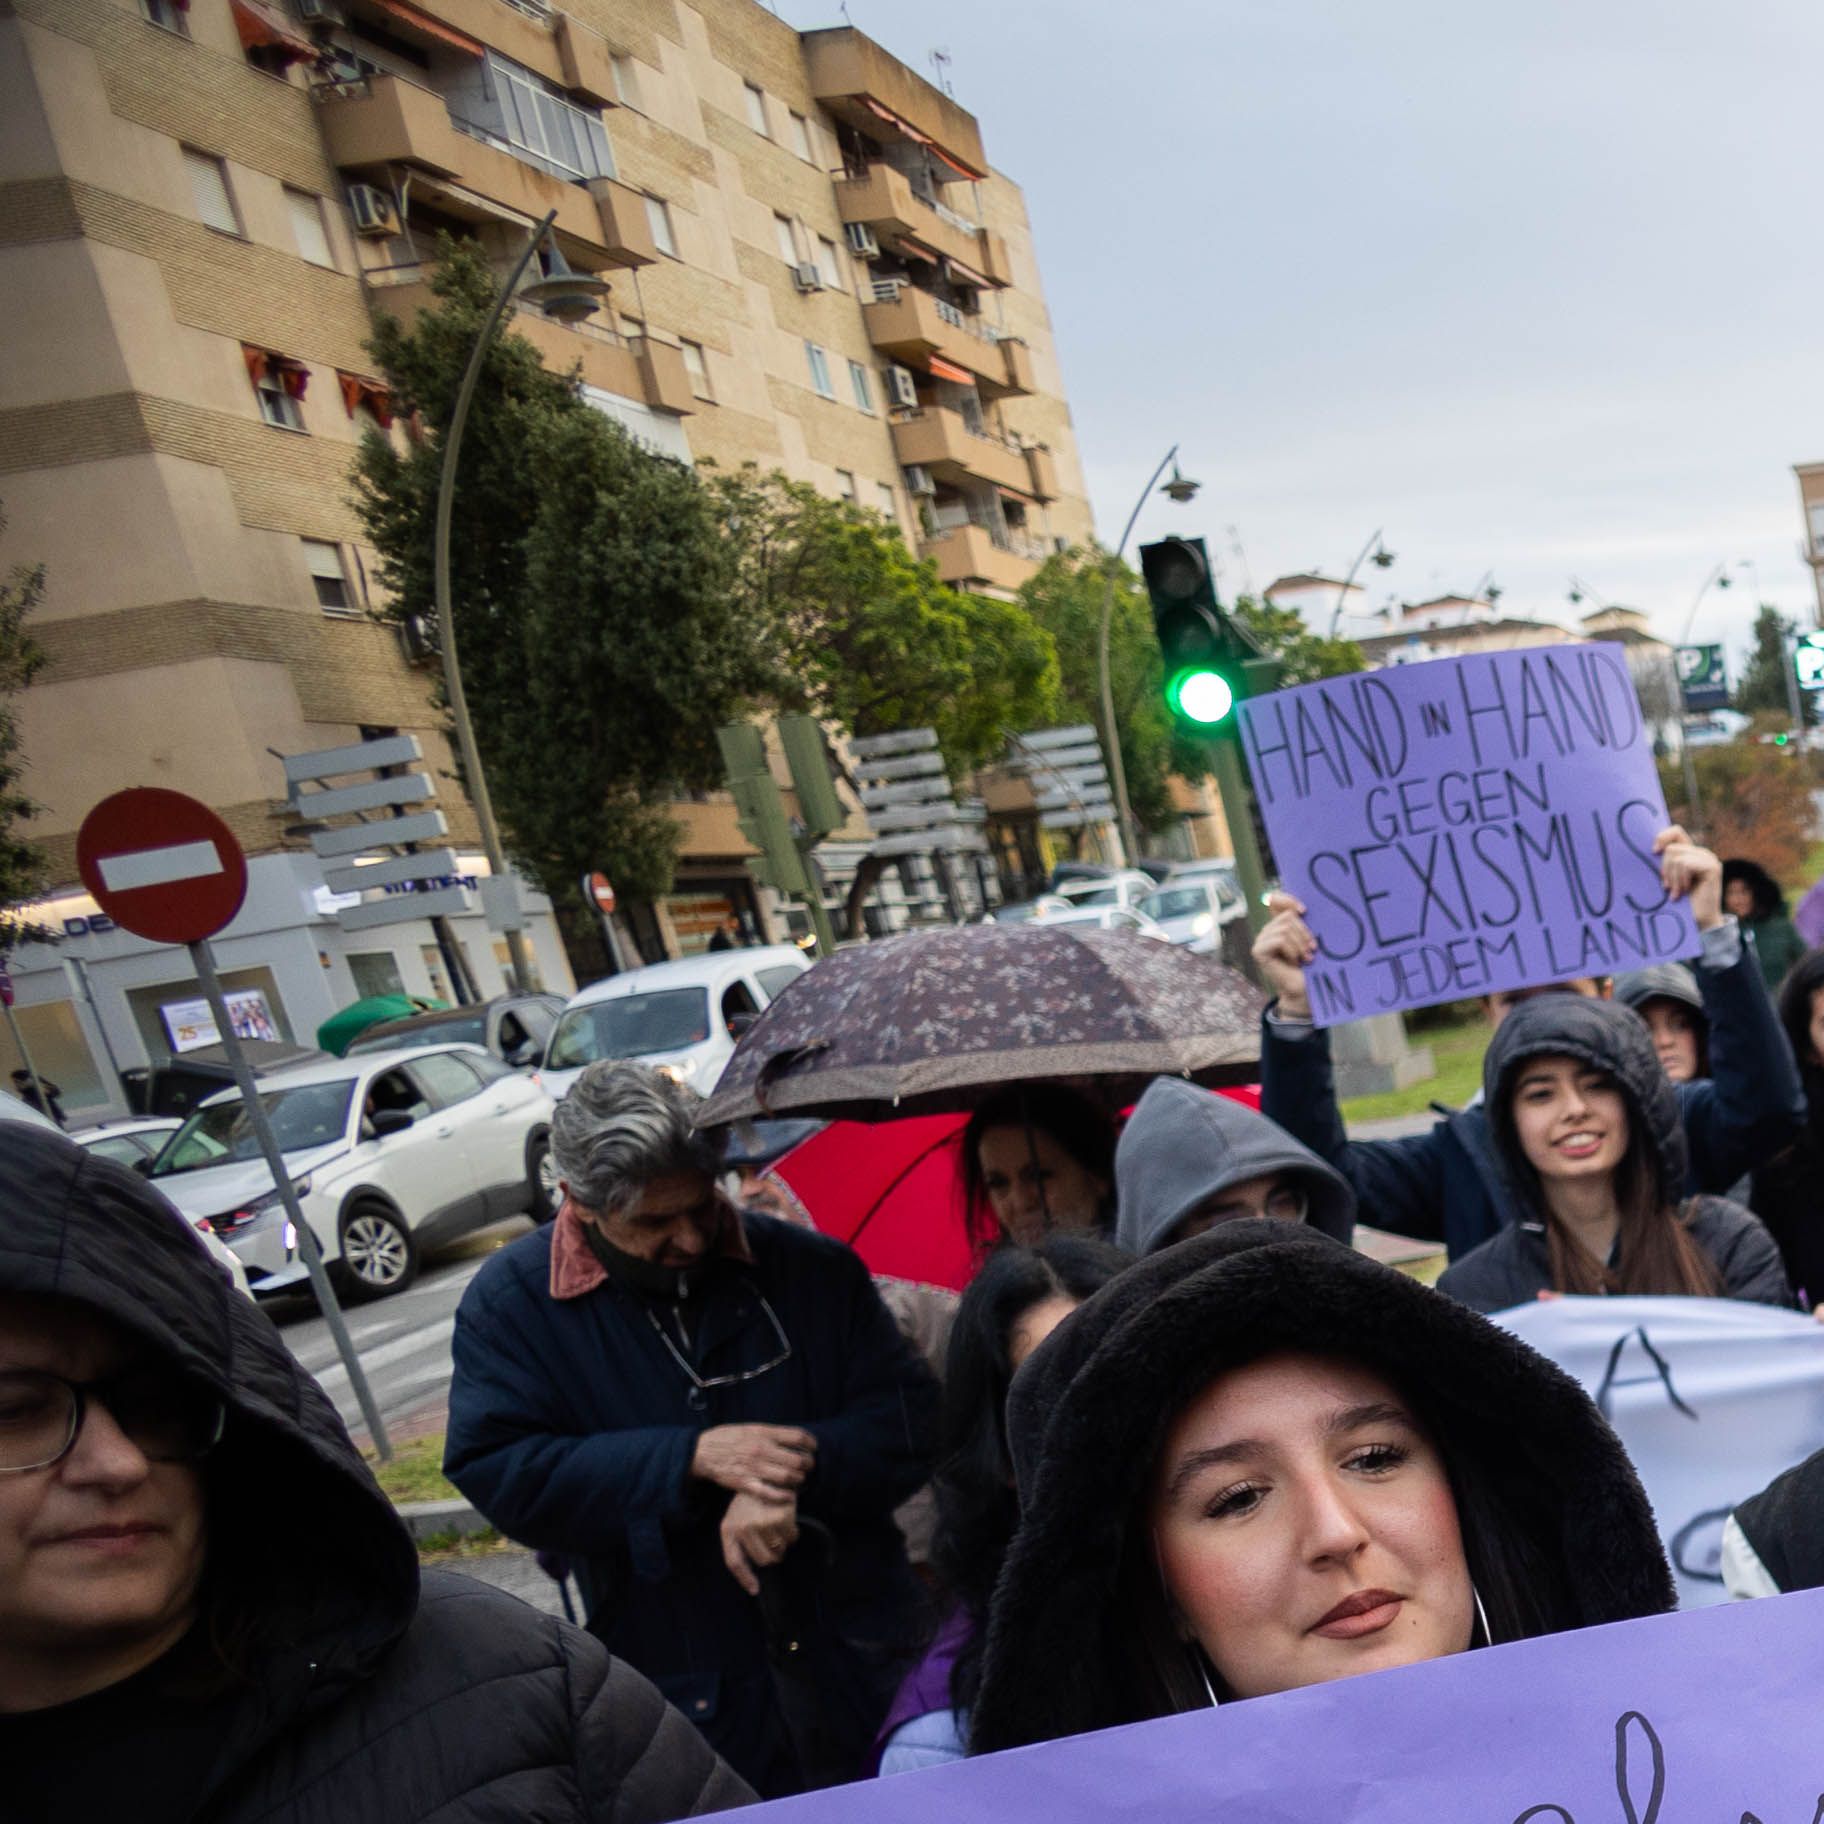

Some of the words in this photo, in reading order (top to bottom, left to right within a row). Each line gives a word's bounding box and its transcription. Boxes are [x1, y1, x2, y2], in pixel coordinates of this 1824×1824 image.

[1239, 677, 1407, 803] HAND
[1420, 700, 1452, 738] IN
[1456, 651, 1638, 764] HAND
[1366, 763, 1550, 843] GEGEN
[1308, 800, 1670, 961] SEXISMUS
[1312, 970, 1358, 1019] IN
[1368, 935, 1527, 1006] JEDEM
[1543, 912, 1687, 976] LAND
